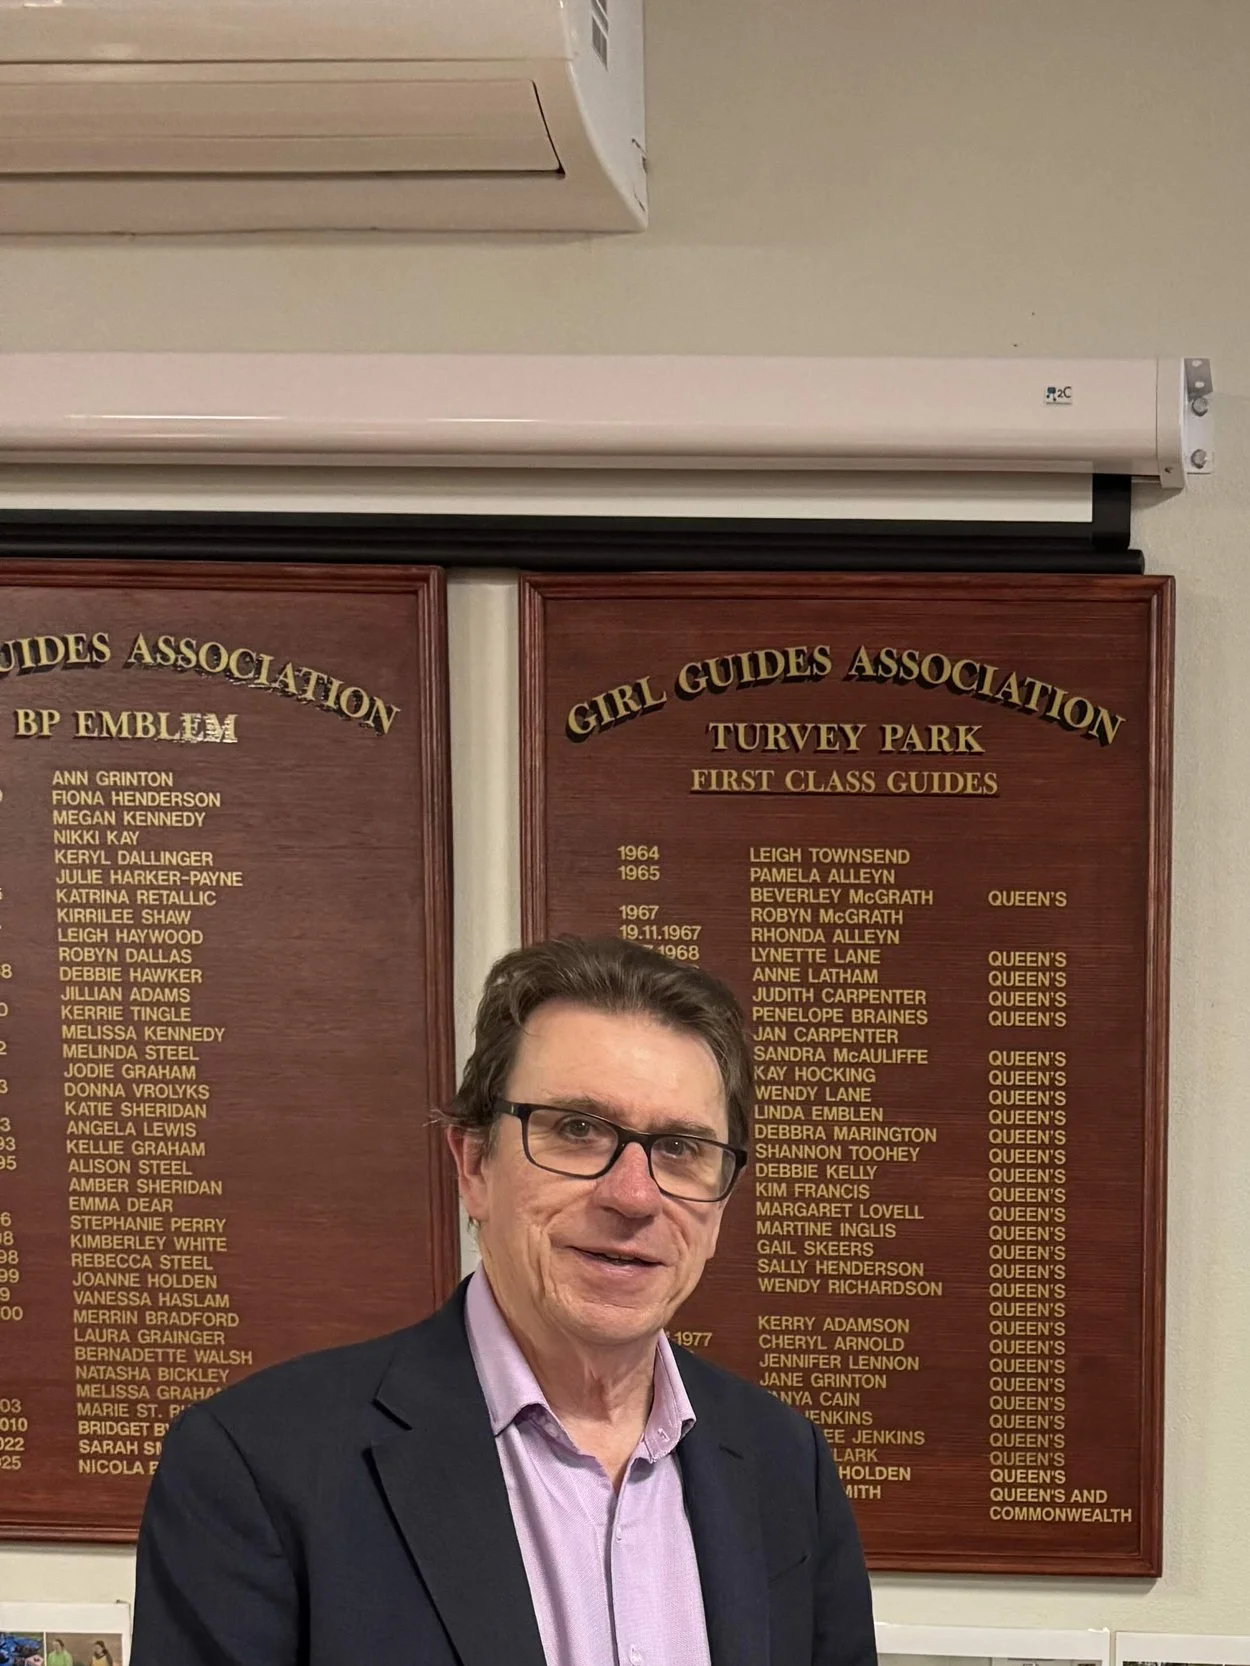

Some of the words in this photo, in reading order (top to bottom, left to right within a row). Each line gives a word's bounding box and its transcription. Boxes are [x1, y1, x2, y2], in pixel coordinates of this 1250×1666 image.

[128, 634, 401, 734] ASSOCIATION
[566, 676, 667, 736] GIRL
[677, 645, 833, 693] GUIDES
[849, 646, 1125, 745] ASSOCIATION
[15, 709, 61, 737] BP
[75, 710, 238, 742] EMBLEM
[708, 723, 866, 751] TURVEY
[881, 725, 985, 753] PARK
[53, 771, 88, 785] ANN
[96, 771, 172, 786] GRINTON
[691, 769, 774, 792] FIRST
[785, 770, 876, 792] CLASS
[887, 772, 998, 795] GUIDES
[53, 790, 104, 805] FIONA
[112, 791, 220, 807] HENDERSON
[53, 810, 115, 825] MEGAN
[124, 811, 205, 826] KENNEDY
[54, 830, 99, 844] NIKKI
[107, 831, 139, 845] KAY
[55, 850, 111, 864] KERYL
[118, 851, 213, 866] DALLINGER
[618, 846, 659, 860] 1964
[751, 848, 801, 862] LEIGH
[809, 848, 909, 864] TOWNSEND
[56, 869, 102, 884] JULIE
[111, 870, 243, 886] HARKER-PAYNE
[619, 865, 659, 880] 1965
[751, 868, 820, 882] PAMELA
[828, 869, 894, 884] ALLEYN
[57, 889, 129, 904] KATRINA
[137, 890, 216, 905] RETALLIC
[751, 888, 841, 903] BEVERLEY
[850, 889, 932, 904] McGRATH
[620, 905, 659, 919] 1967
[751, 908, 811, 922] ROBYN
[820, 909, 902, 924] McGRATH
[58, 928, 108, 942] LEIGH
[116, 929, 203, 944] HAYWOOD
[620, 925, 701, 940] 19.11.1967
[752, 928, 825, 943] RHONDA
[833, 929, 899, 944] ALLEYN
[60, 967, 122, 981] DEBBIE
[130, 968, 202, 983] HAWKER
[753, 987, 813, 1002] JUDITH
[822, 988, 926, 1004] CARPENTER
[61, 1005, 123, 1020] KERRIE
[130, 1007, 191, 1021] TINGLE
[754, 1046, 825, 1061] SANDRA
[834, 1048, 928, 1063] McAULIFFE
[65, 1083, 125, 1097] DONNA
[133, 1084, 209, 1099] VROLYKS
[67, 1121, 136, 1135] ANGELA
[144, 1122, 196, 1137] LEWIS
[757, 1202, 852, 1217] MARGARET
[860, 1204, 924, 1219] LOVELL
[758, 1259, 808, 1273] SALLY
[816, 1260, 923, 1276] HENDERSON
[758, 1278, 820, 1292] WENDY
[829, 1280, 942, 1295] RICHARDSON
[74, 1310, 137, 1324] MERRIN
[146, 1311, 239, 1326] BRADFORD
[75, 1347, 187, 1363] BERNADETTE
[194, 1350, 252, 1364] WALSH
[760, 1354, 841, 1368] JENNIFER
[850, 1356, 918, 1370] LENNON
[79, 1421, 150, 1436] BRIDGET
[79, 1460, 144, 1474] NICOLA
[839, 1466, 910, 1480] HOLDEN
[1071, 1490, 1107, 1503] AND
[990, 1506, 1131, 1522] COMMONWEALTH
